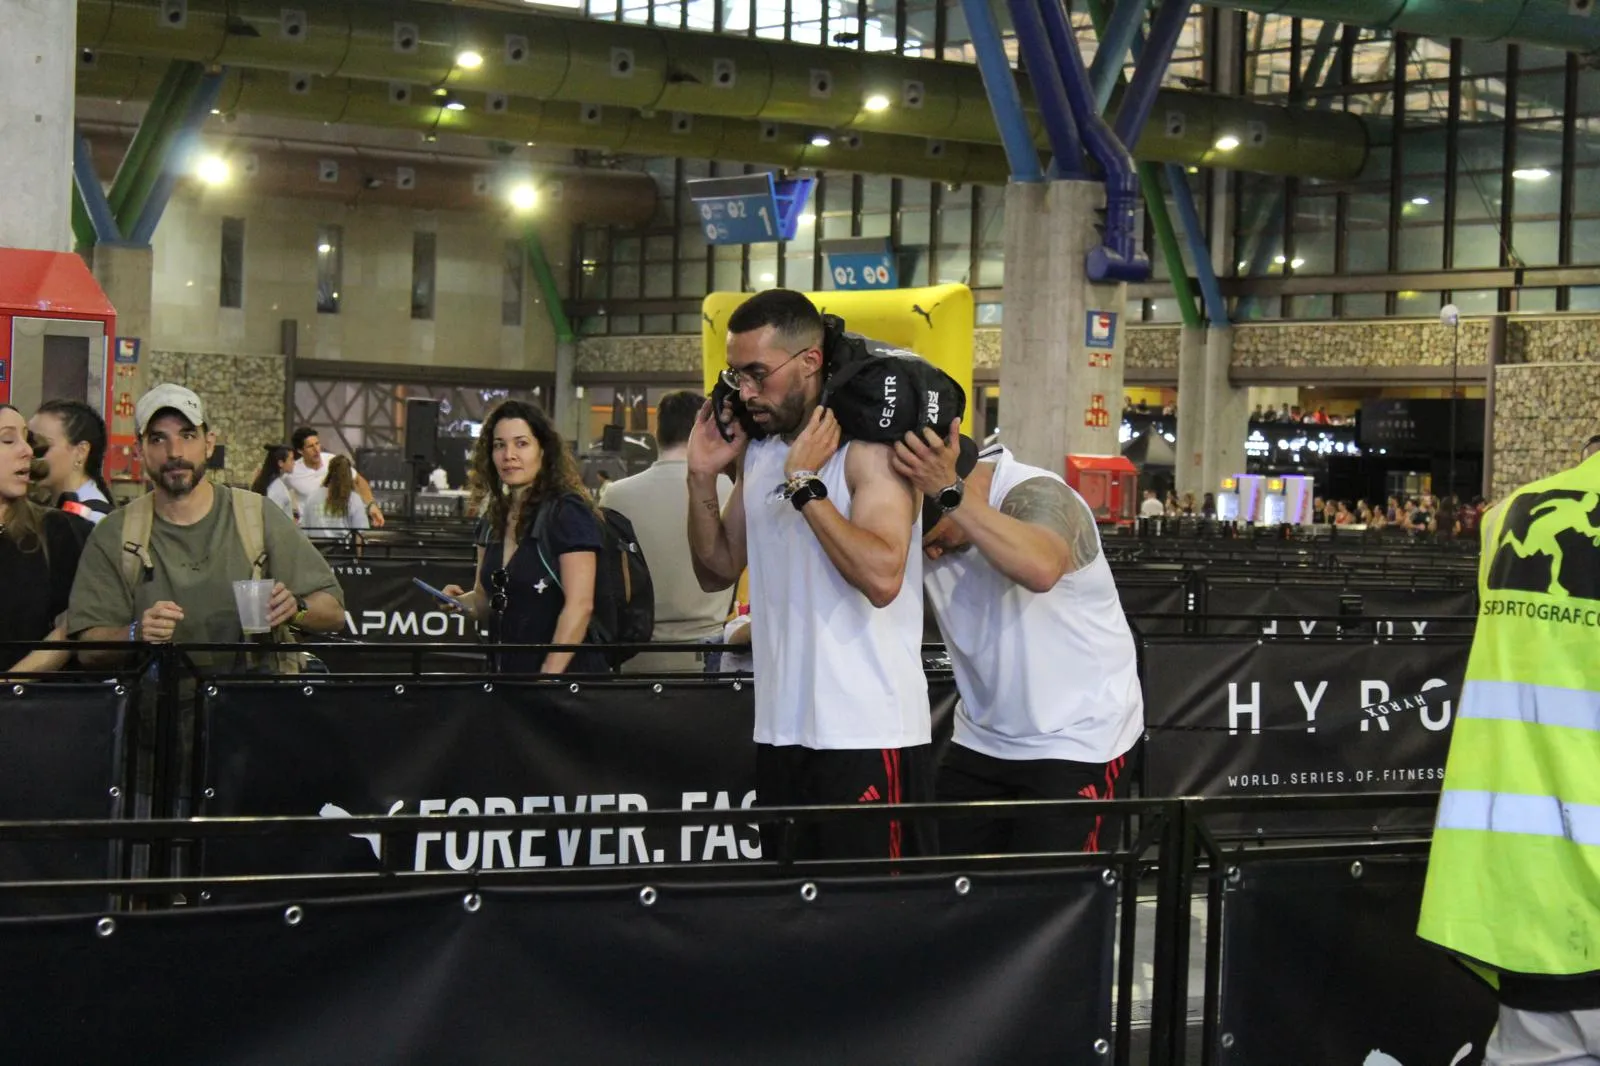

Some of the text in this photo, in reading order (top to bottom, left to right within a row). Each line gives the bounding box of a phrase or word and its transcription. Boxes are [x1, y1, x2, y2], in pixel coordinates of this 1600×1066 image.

[758, 206, 773, 236] 1
[1364, 694, 1426, 718] HYROX
[414, 793, 665, 872] FOREVER.
